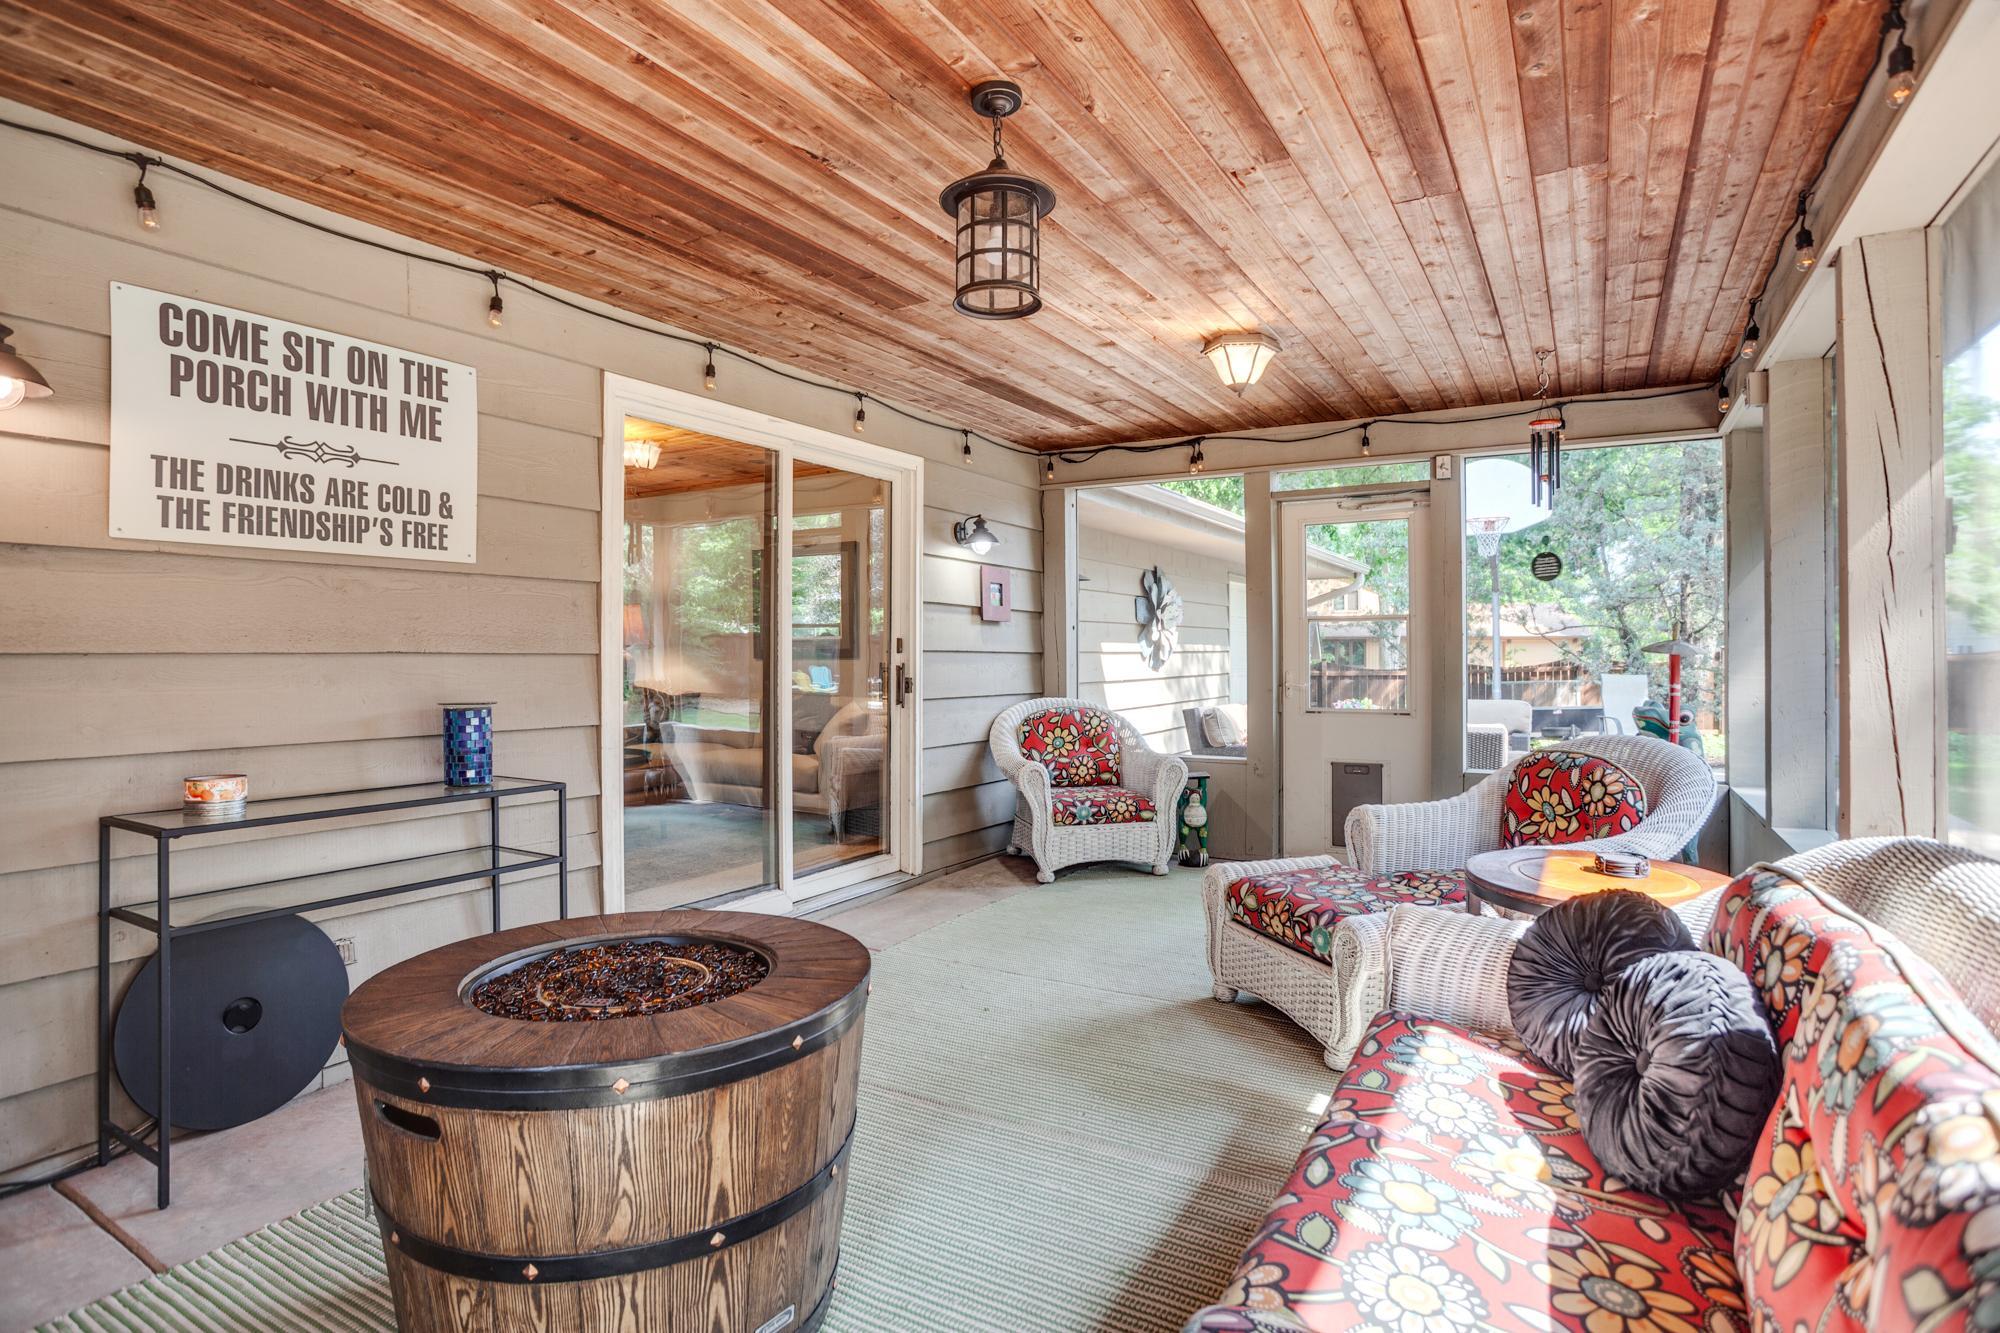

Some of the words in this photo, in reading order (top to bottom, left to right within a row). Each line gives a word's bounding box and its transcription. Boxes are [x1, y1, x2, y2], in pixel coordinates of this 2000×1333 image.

[159, 302, 268, 365] COME
[282, 330, 335, 377] SIT
[347, 346, 388, 390] ON
[399, 358, 448, 402] THE
[170, 353, 292, 416] PORCH
[306, 380, 388, 433] WITH
[399, 400, 442, 442] ME
[150, 454, 205, 492] THE
[217, 462, 315, 504] DRINKS
[325, 477, 369, 510] ARE
[378, 484, 430, 516] COLD
[439, 492, 453, 519] &
[157, 495, 211, 531] THE
[222, 502, 393, 546] FRIENDSHIP'S
[402, 521, 448, 551] FREE
